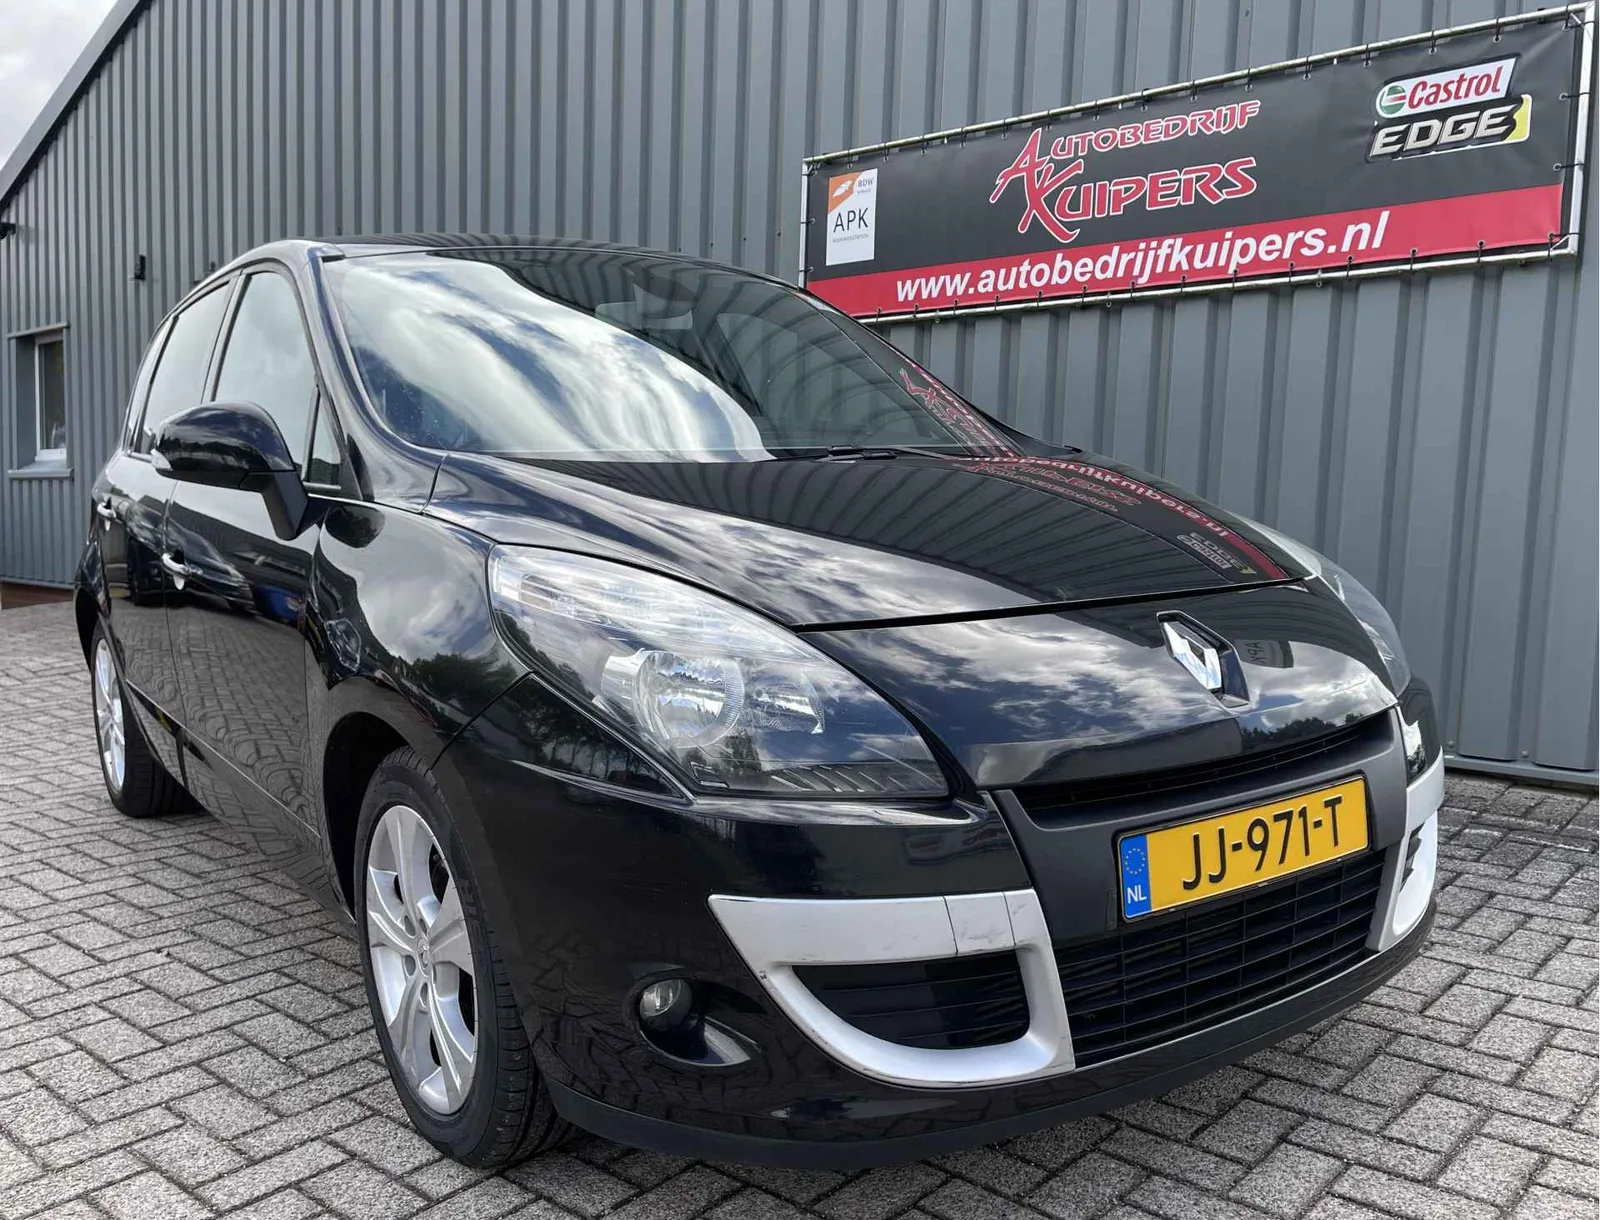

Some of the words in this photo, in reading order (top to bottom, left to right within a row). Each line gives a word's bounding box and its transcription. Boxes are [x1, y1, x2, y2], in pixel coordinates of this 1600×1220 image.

[1408, 65, 1503, 109] Castrol
[1369, 104, 1518, 157] EDGE
[833, 207, 868, 233] APK
[896, 210, 1390, 303] www.autobedrijfkuipers.nl
[1182, 795, 1343, 890] JJ-971-T
[1126, 884, 1147, 904] NL
